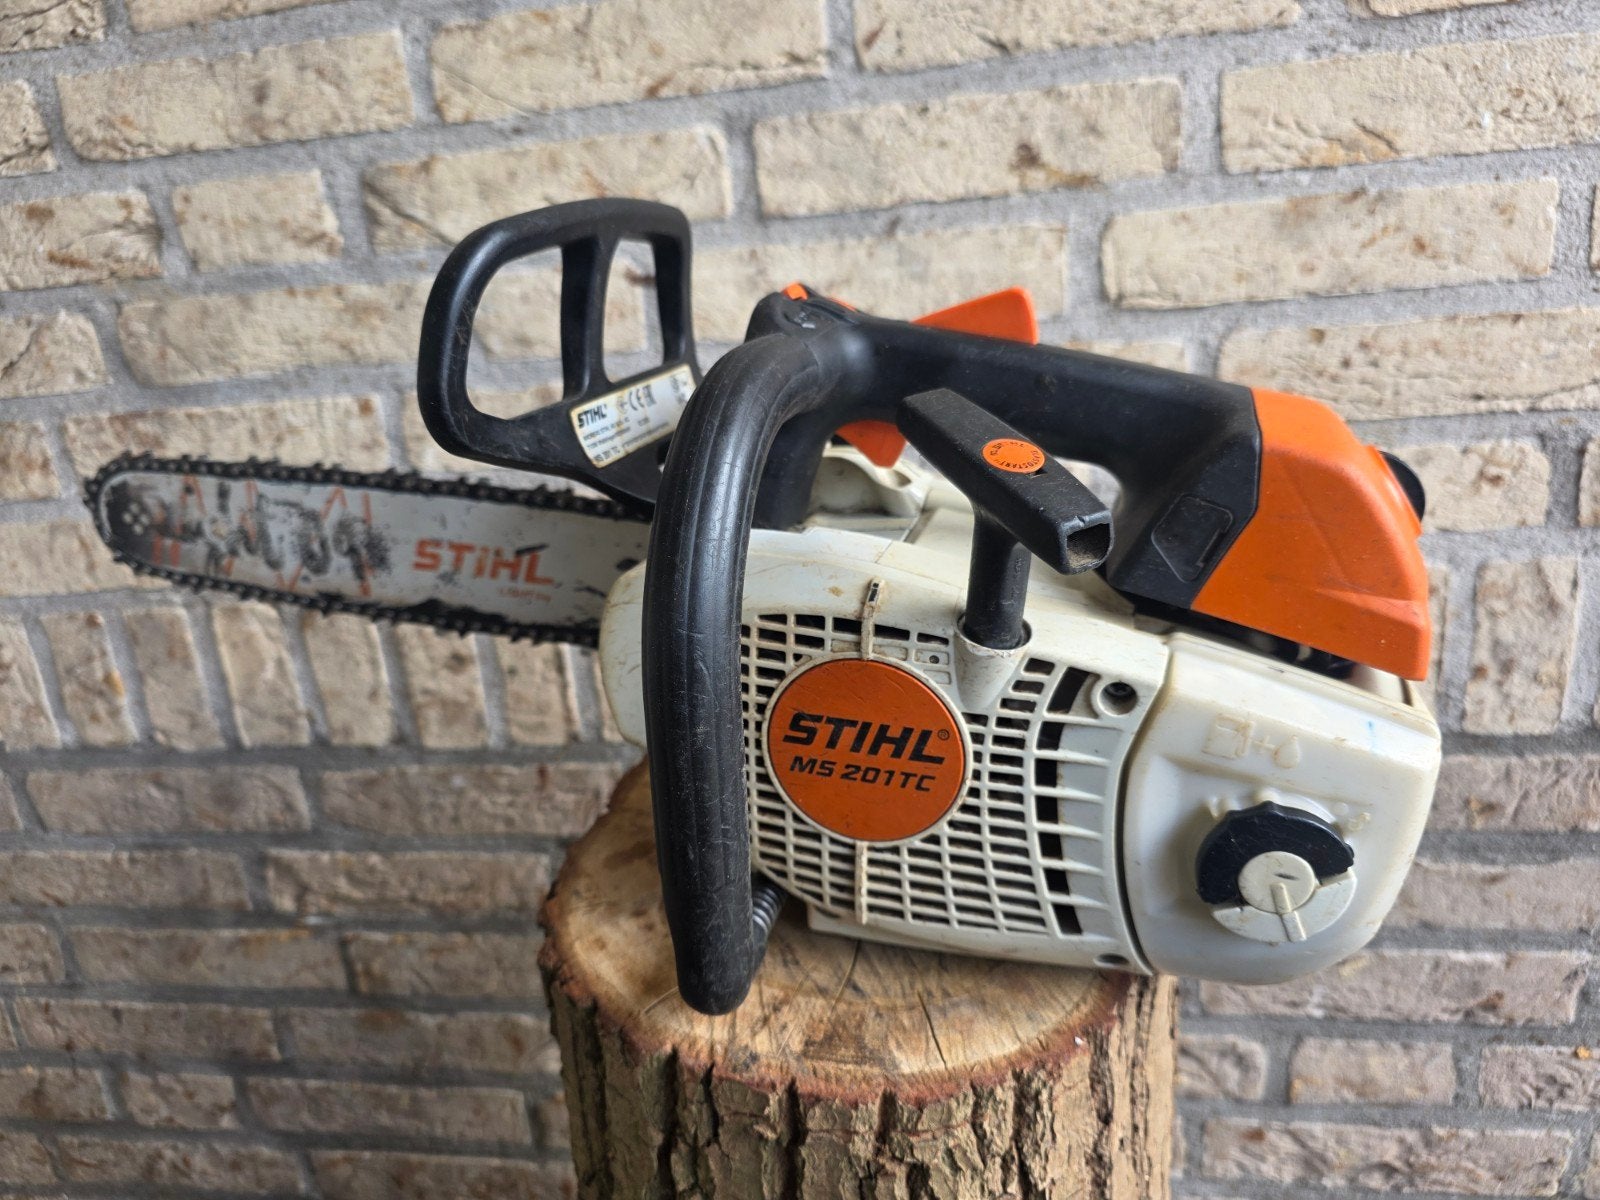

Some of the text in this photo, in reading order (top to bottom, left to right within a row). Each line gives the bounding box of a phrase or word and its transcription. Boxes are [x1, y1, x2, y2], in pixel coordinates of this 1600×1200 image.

[577, 406, 606, 429] STIHL
[412, 537, 555, 586] STIHL
[789, 756, 837, 778] MS
